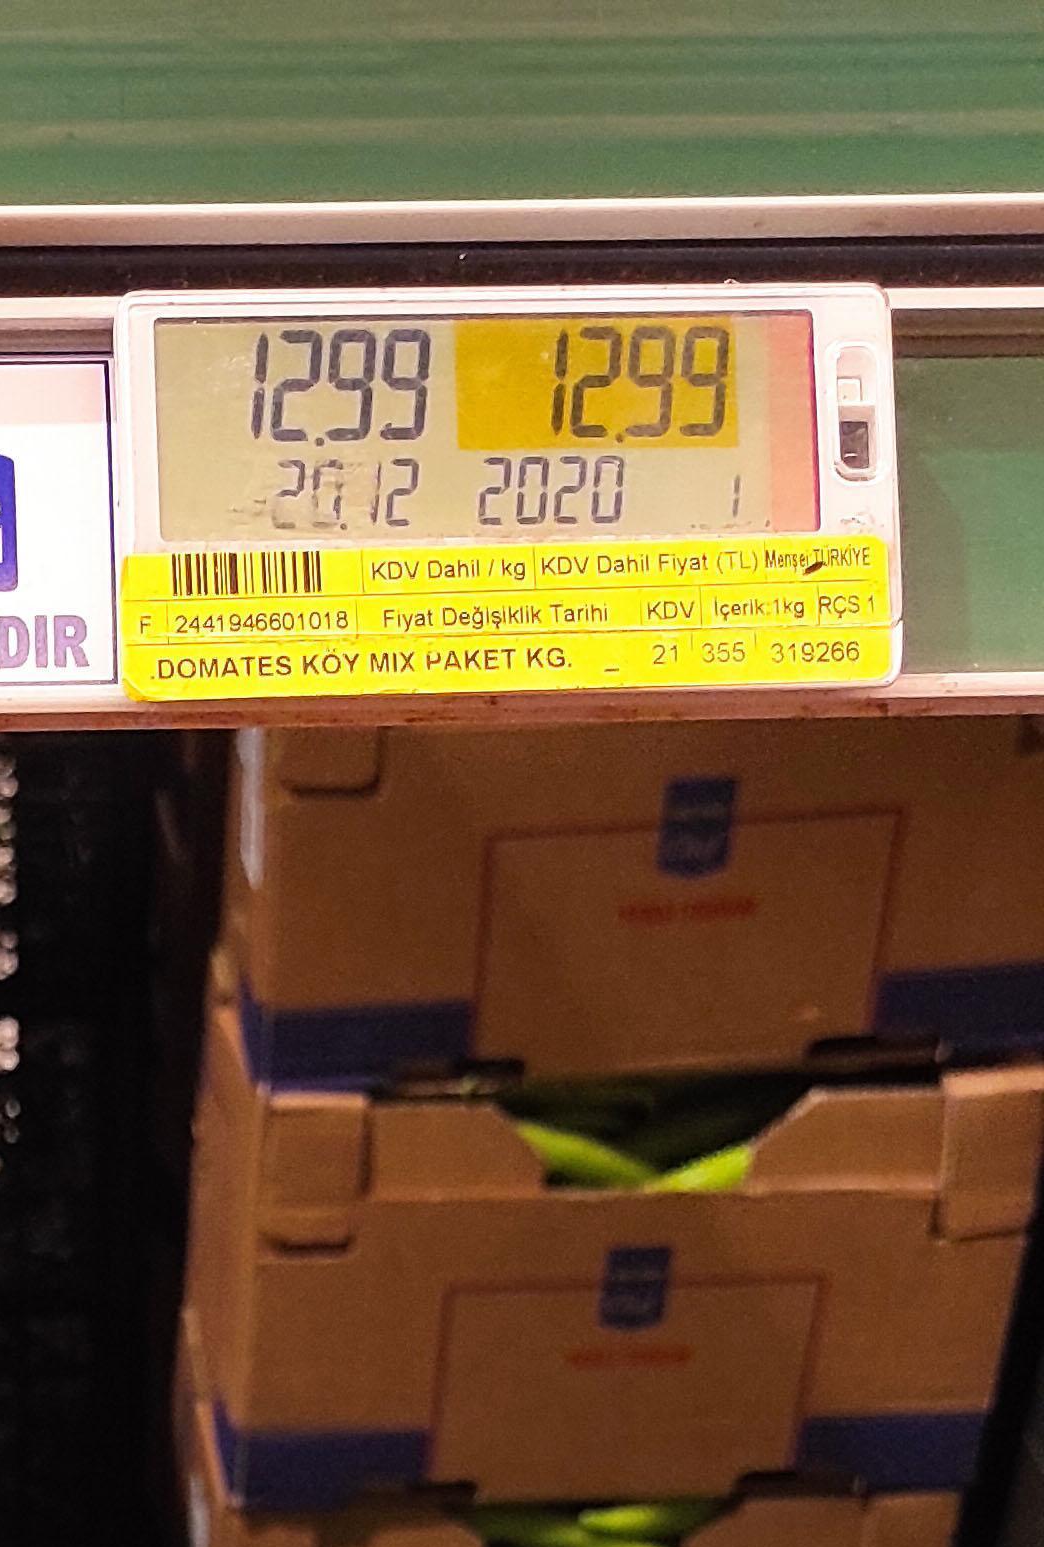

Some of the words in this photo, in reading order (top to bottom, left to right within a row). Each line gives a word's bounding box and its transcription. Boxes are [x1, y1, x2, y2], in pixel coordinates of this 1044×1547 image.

[251, 328, 432, 447] 12.99
[551, 324, 731, 443] 12.99
[478, 454, 625, 526] 2020
[371, 560, 420, 581] KDV
[428, 558, 481, 579] Dahil
[501, 556, 526, 580] kg
[541, 555, 589, 575] KDV
[597, 553, 650, 575] Dahil
[658, 552, 709, 579] Fiyat
[716, 550, 758, 574] (TL)
[383, 608, 434, 632] Fiyat
[549, 603, 608, 624] Tarihi
[647, 600, 696, 620] KDV
[819, 595, 860, 619] RÇS
[867, 594, 875, 614] 1
[140, 616, 152, 634] F
[175, 610, 349, 633] 2441946601018
[370, 652, 416, 673] MIX
[426, 648, 516, 671] PAKET
[652, 644, 679, 665] 21
[701, 641, 746, 663] 355
[771, 640, 861, 663] 319266
